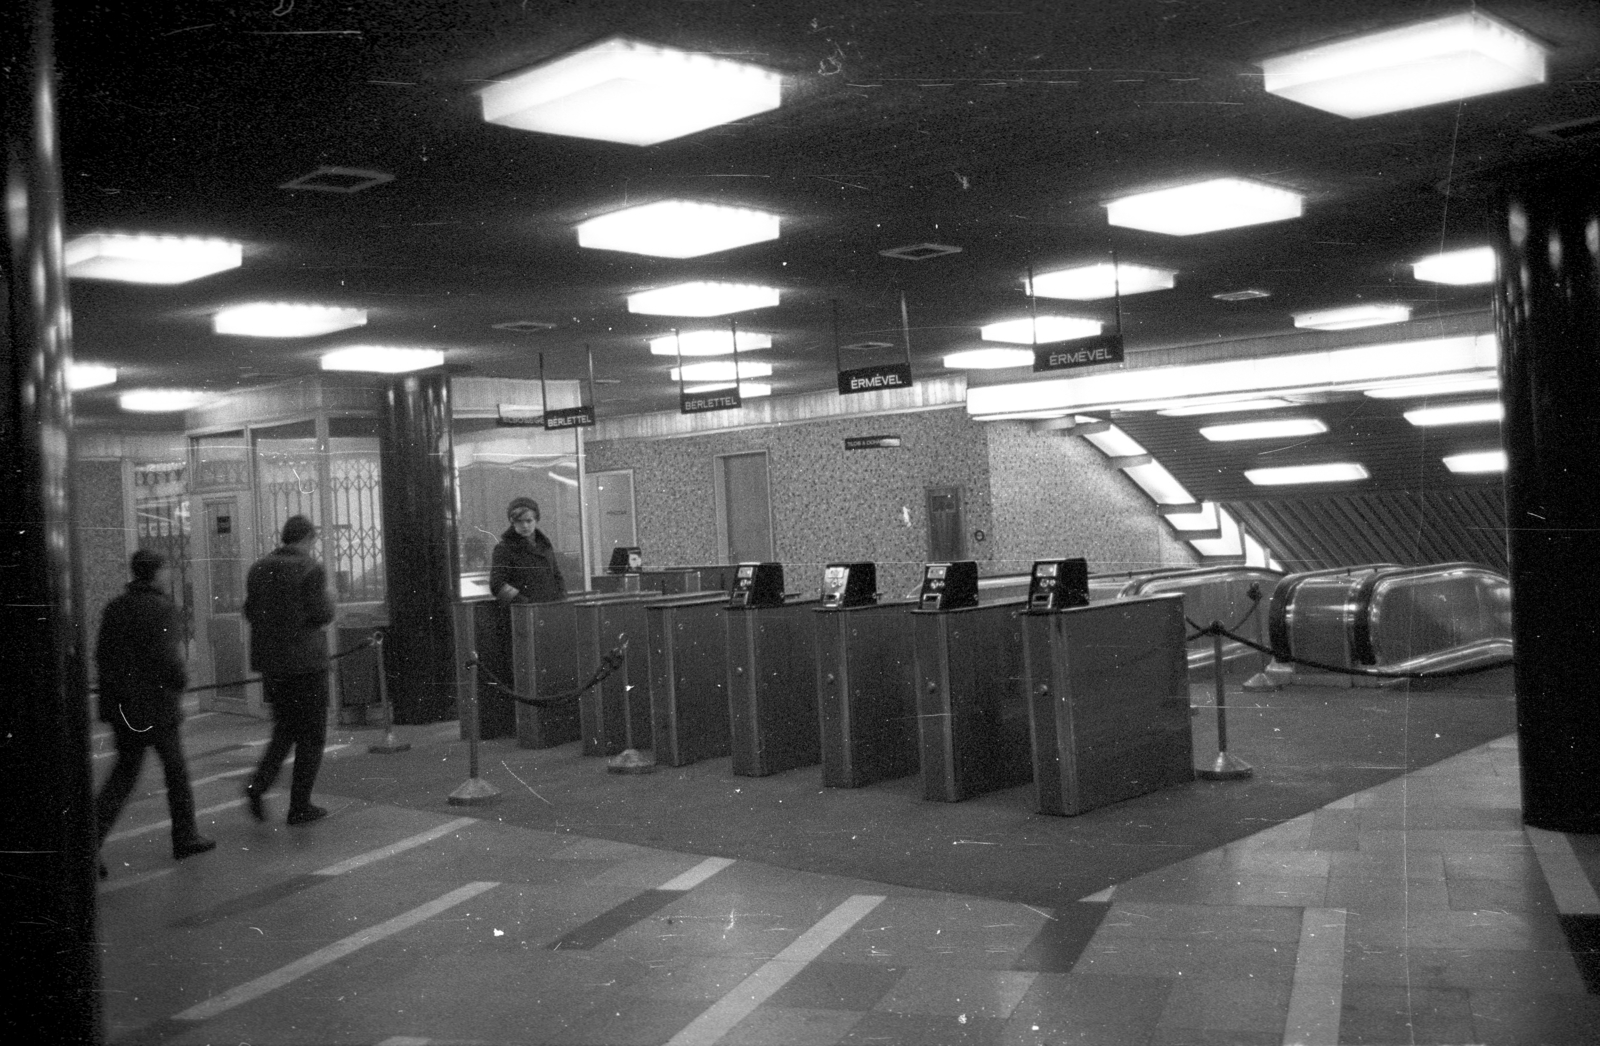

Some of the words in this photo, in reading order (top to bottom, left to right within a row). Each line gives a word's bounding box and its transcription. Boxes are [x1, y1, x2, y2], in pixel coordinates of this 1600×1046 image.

[1049, 348, 1112, 366] ÉRMÉVEL
[851, 373, 902, 390] ÉRMÉVEL
[685, 396, 737, 410] BÉRLETTEL
[547, 415, 591, 428] BÉRLETTEL
